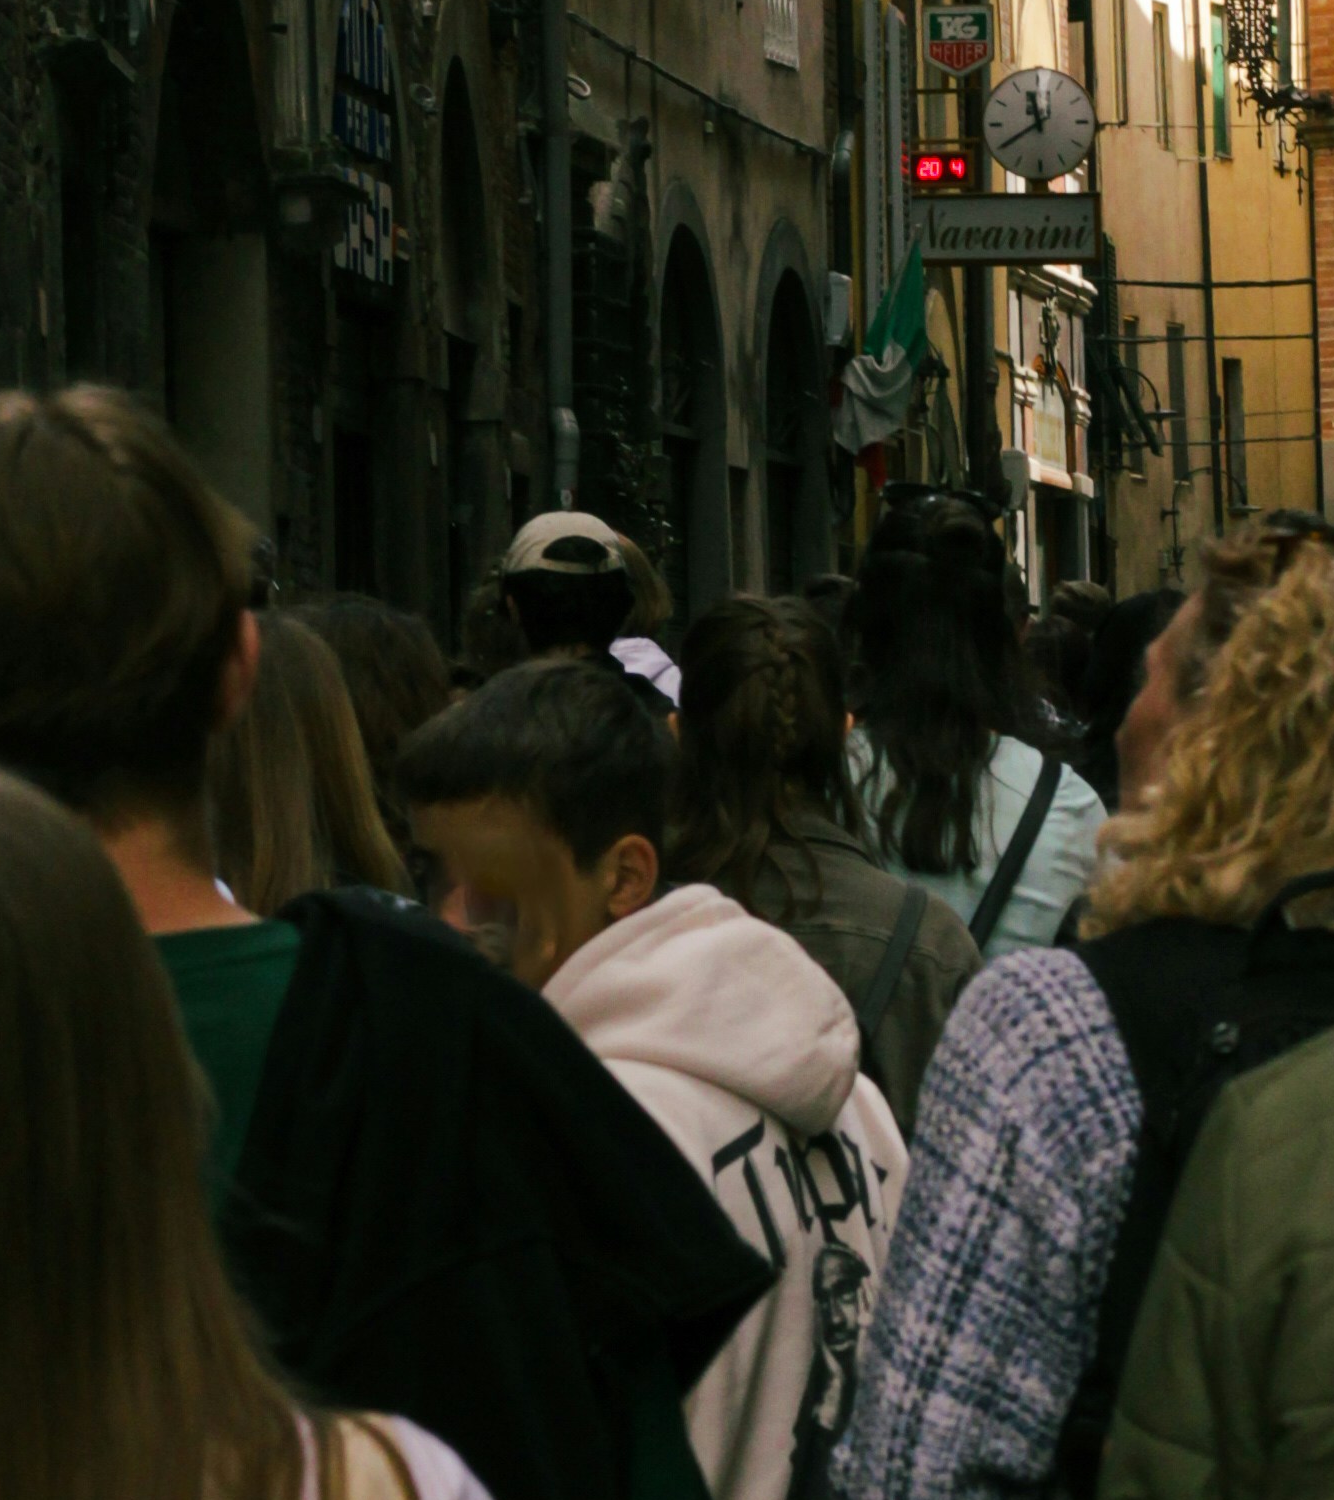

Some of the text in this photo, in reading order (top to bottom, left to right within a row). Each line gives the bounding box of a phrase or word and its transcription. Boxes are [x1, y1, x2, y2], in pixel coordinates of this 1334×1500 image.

[937, 14, 980, 40] TAG
[933, 43, 985, 69] HEUER
[919, 159, 963, 178] 20 4
[923, 203, 1091, 251] Navarrini
